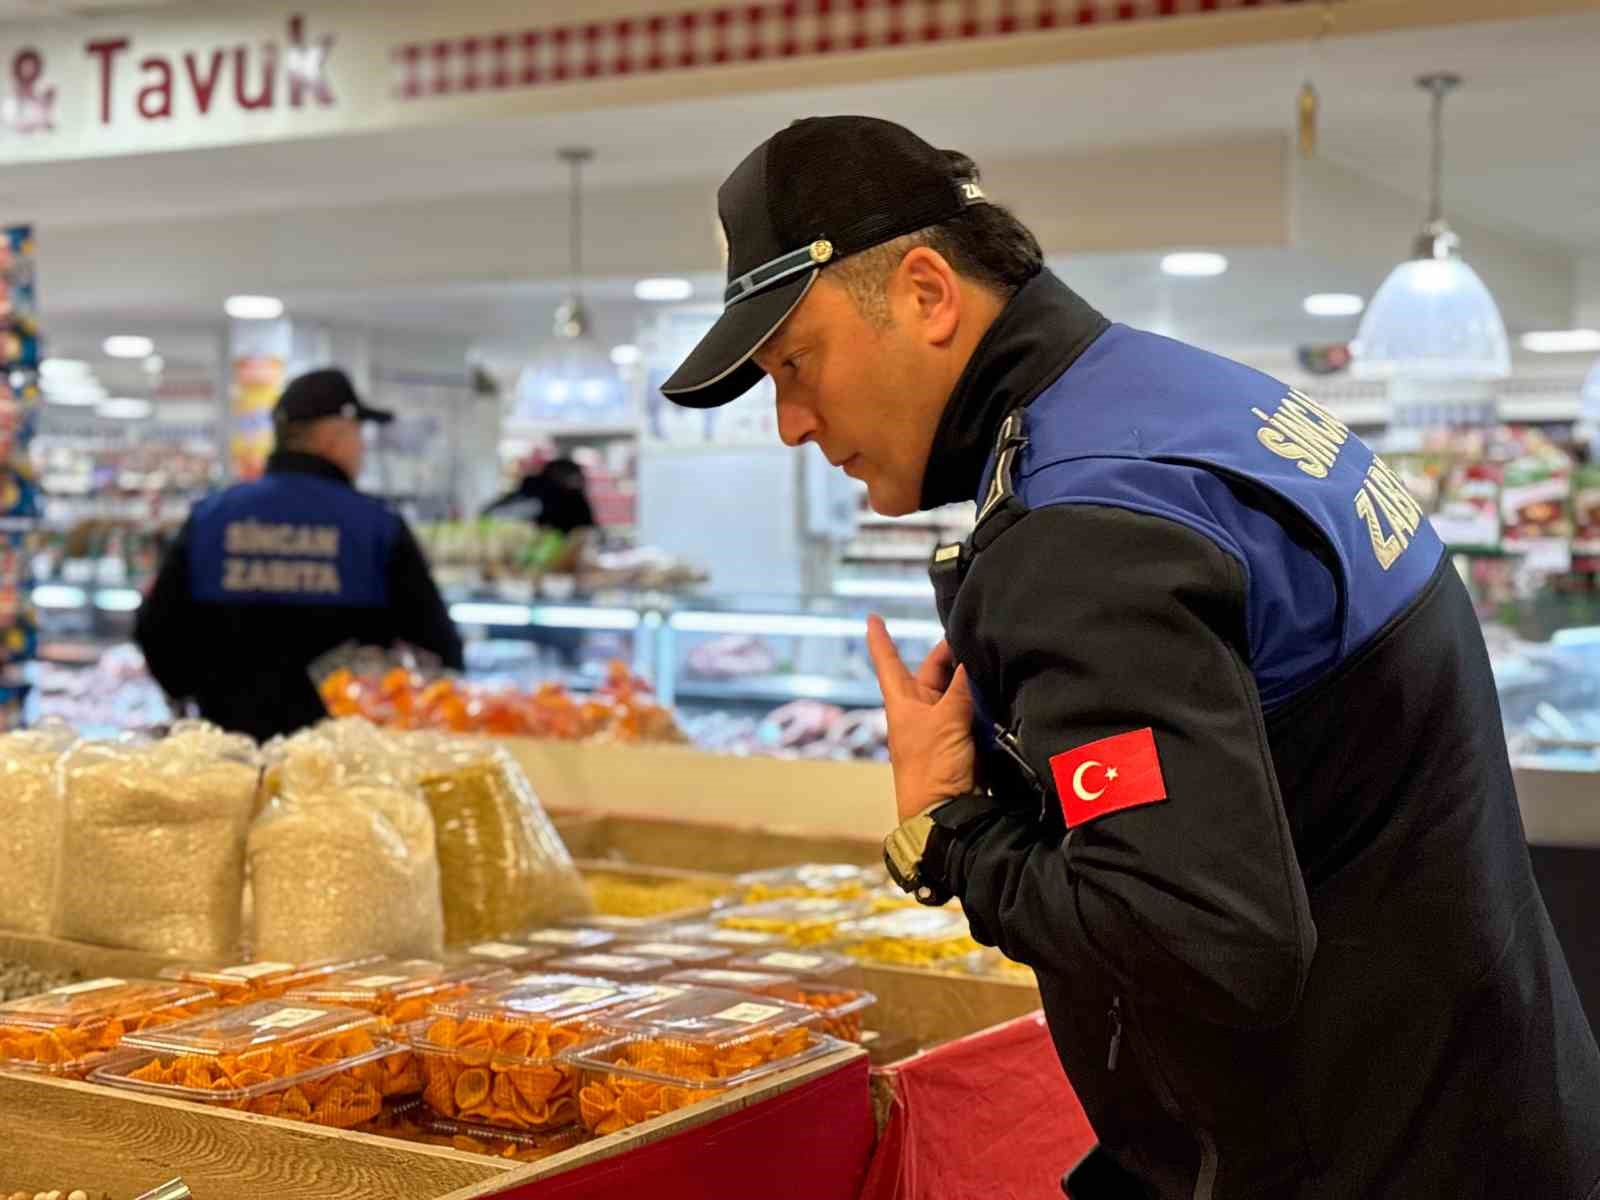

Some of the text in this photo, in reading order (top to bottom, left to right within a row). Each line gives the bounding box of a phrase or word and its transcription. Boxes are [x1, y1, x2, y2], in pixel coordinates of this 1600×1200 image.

[84, 14, 337, 124] Tavuk
[1353, 454, 1423, 570] ZABI
[223, 558, 341, 593] ZABITA
